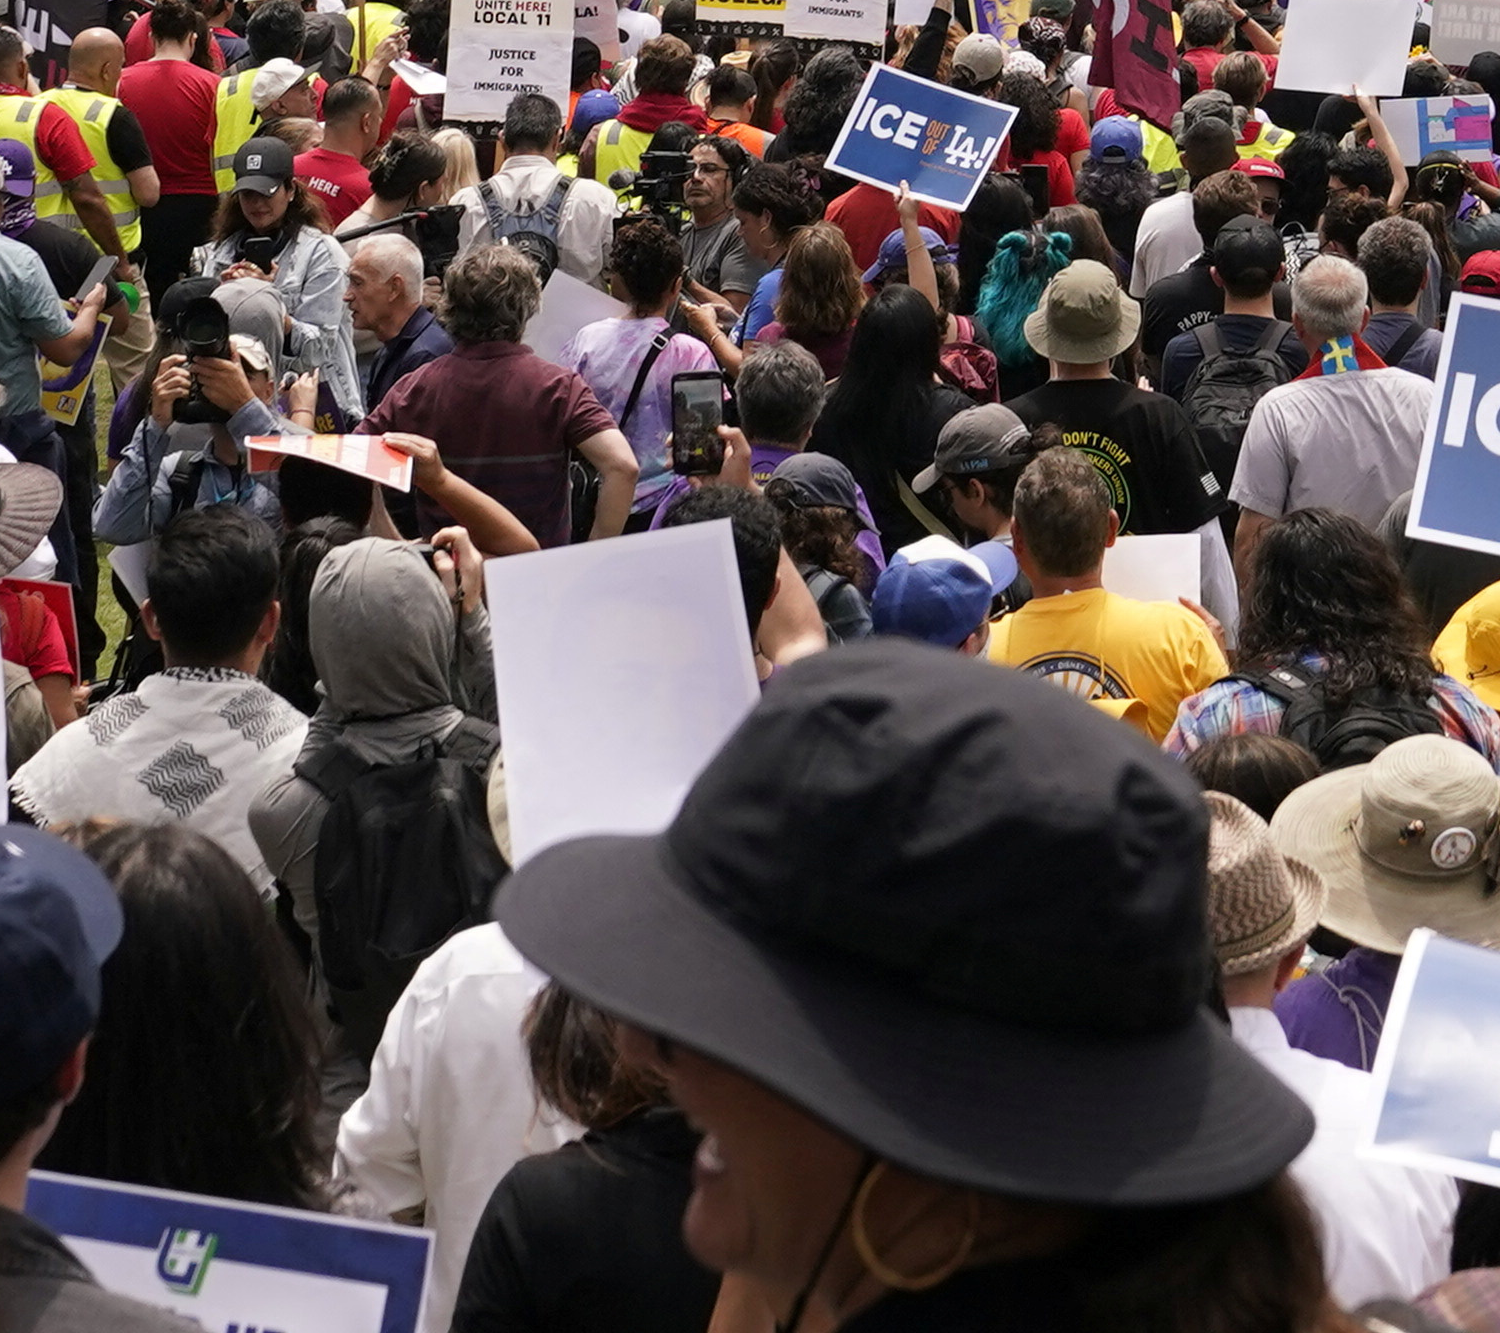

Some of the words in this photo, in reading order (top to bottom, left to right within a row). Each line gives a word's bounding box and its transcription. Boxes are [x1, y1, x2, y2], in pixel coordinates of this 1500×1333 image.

[474, 11, 528, 25] LOCAL
[536, 14, 551, 26] 11
[488, 49, 536, 61] JUSTICE
[500, 66, 524, 77] FOR
[855, 96, 929, 150] ICE
[926, 119, 951, 140] OUT
[921, 139, 940, 155] OF
[944, 125, 996, 169] LA!
[308, 177, 340, 197] HERE
[1062, 432, 1100, 447] DON'T
[1100, 436, 1132, 467] FIGHT
[1111, 473, 1124, 505] UNION
